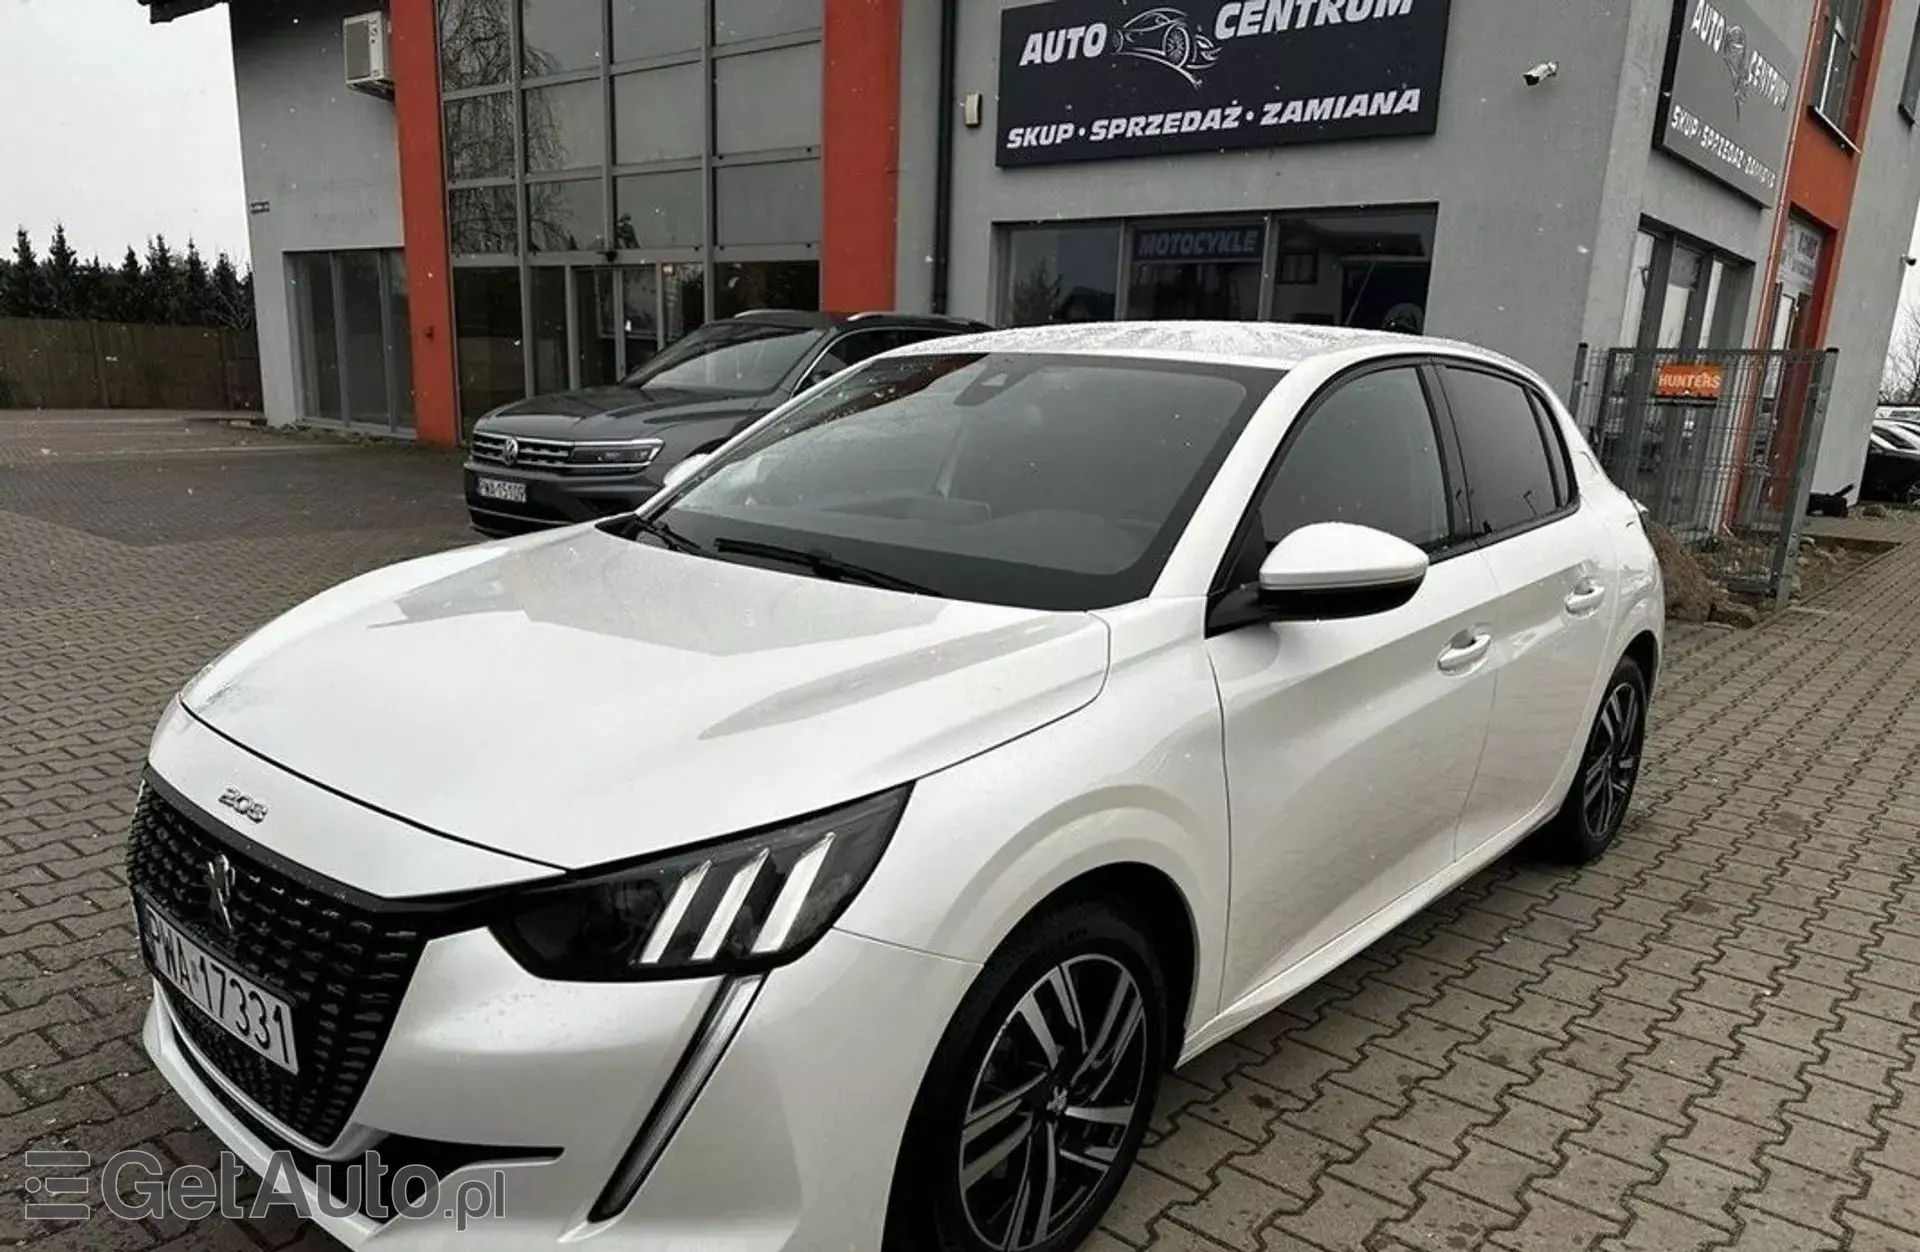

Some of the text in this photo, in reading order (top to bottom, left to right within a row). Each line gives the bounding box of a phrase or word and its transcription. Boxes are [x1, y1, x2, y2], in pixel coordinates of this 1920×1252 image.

[1019, 22, 1108, 66] AUTO
[1691, 0, 1725, 52] AUTO
[1006, 88, 1421, 149] SKUP SPRZEDAŻ ZAMIANA
[1139, 230, 1258, 257] MOTOCYKLE
[1658, 372, 1720, 389] HUNTERS
[218, 786, 269, 824] 208
[199, 955, 290, 1065] 17331
